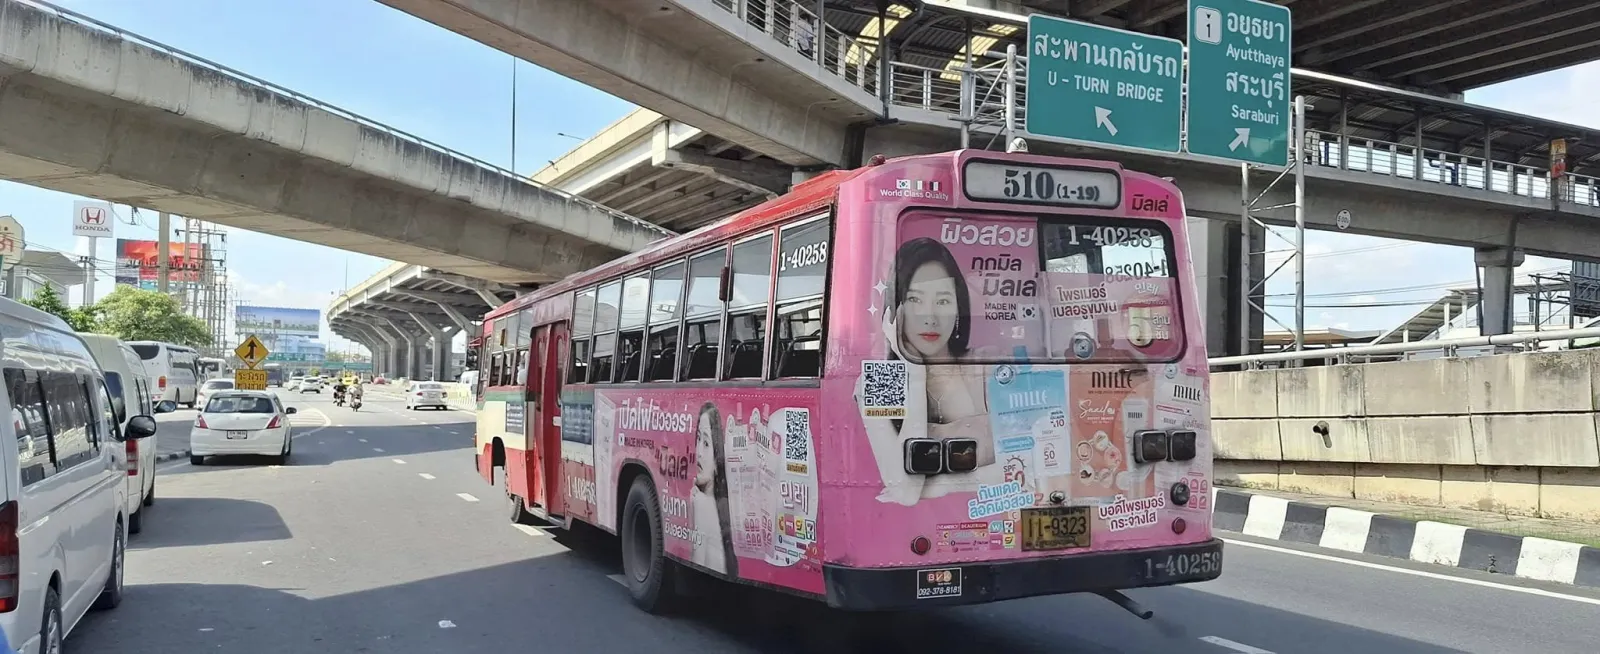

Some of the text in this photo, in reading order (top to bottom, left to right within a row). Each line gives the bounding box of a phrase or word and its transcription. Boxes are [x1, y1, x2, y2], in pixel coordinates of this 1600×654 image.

[1206, 23, 1211, 38] 1
[1227, 12, 1284, 44] อยุธยา
[1034, 33, 1177, 78] สะพานกลับรถ
[1226, 44, 1284, 67] Ayutthaya
[1074, 75, 1109, 94] TURN
[1117, 83, 1163, 103] BRIDGE
[1226, 71, 1284, 108] สระบุรี
[1231, 105, 1279, 125] Saraburi
[880, 189, 948, 201] World Class Quality
[1004, 169, 1100, 201] 510 (1-19)
[1131, 194, 1168, 213] มิลเล่
[941, 218, 1034, 247] ผิวสวย
[1068, 225, 1152, 248] 1-40258
[781, 241, 827, 271] 1-40258
[971, 254, 1022, 276] ทุกมิล
[983, 272, 1039, 297] มิลเล่
[1057, 283, 1106, 301] ไพรเมอร์
[985, 312, 1016, 321] KOREA
[1053, 302, 1117, 319] เบลอรูขุมขน
[1092, 371, 1133, 388] MILLE
[1009, 390, 1048, 408] MILLE
[1173, 384, 1201, 401] MILLE
[619, 397, 692, 433] เปิดไฟผิวออร่า
[1003, 464, 1016, 473] SPF
[979, 482, 1020, 499] กันแดด
[1100, 494, 1164, 517] บอดี้ไพรเมอร์
[1110, 510, 1156, 530] กระจ่างใส
[1144, 551, 1220, 579] 1-40258
